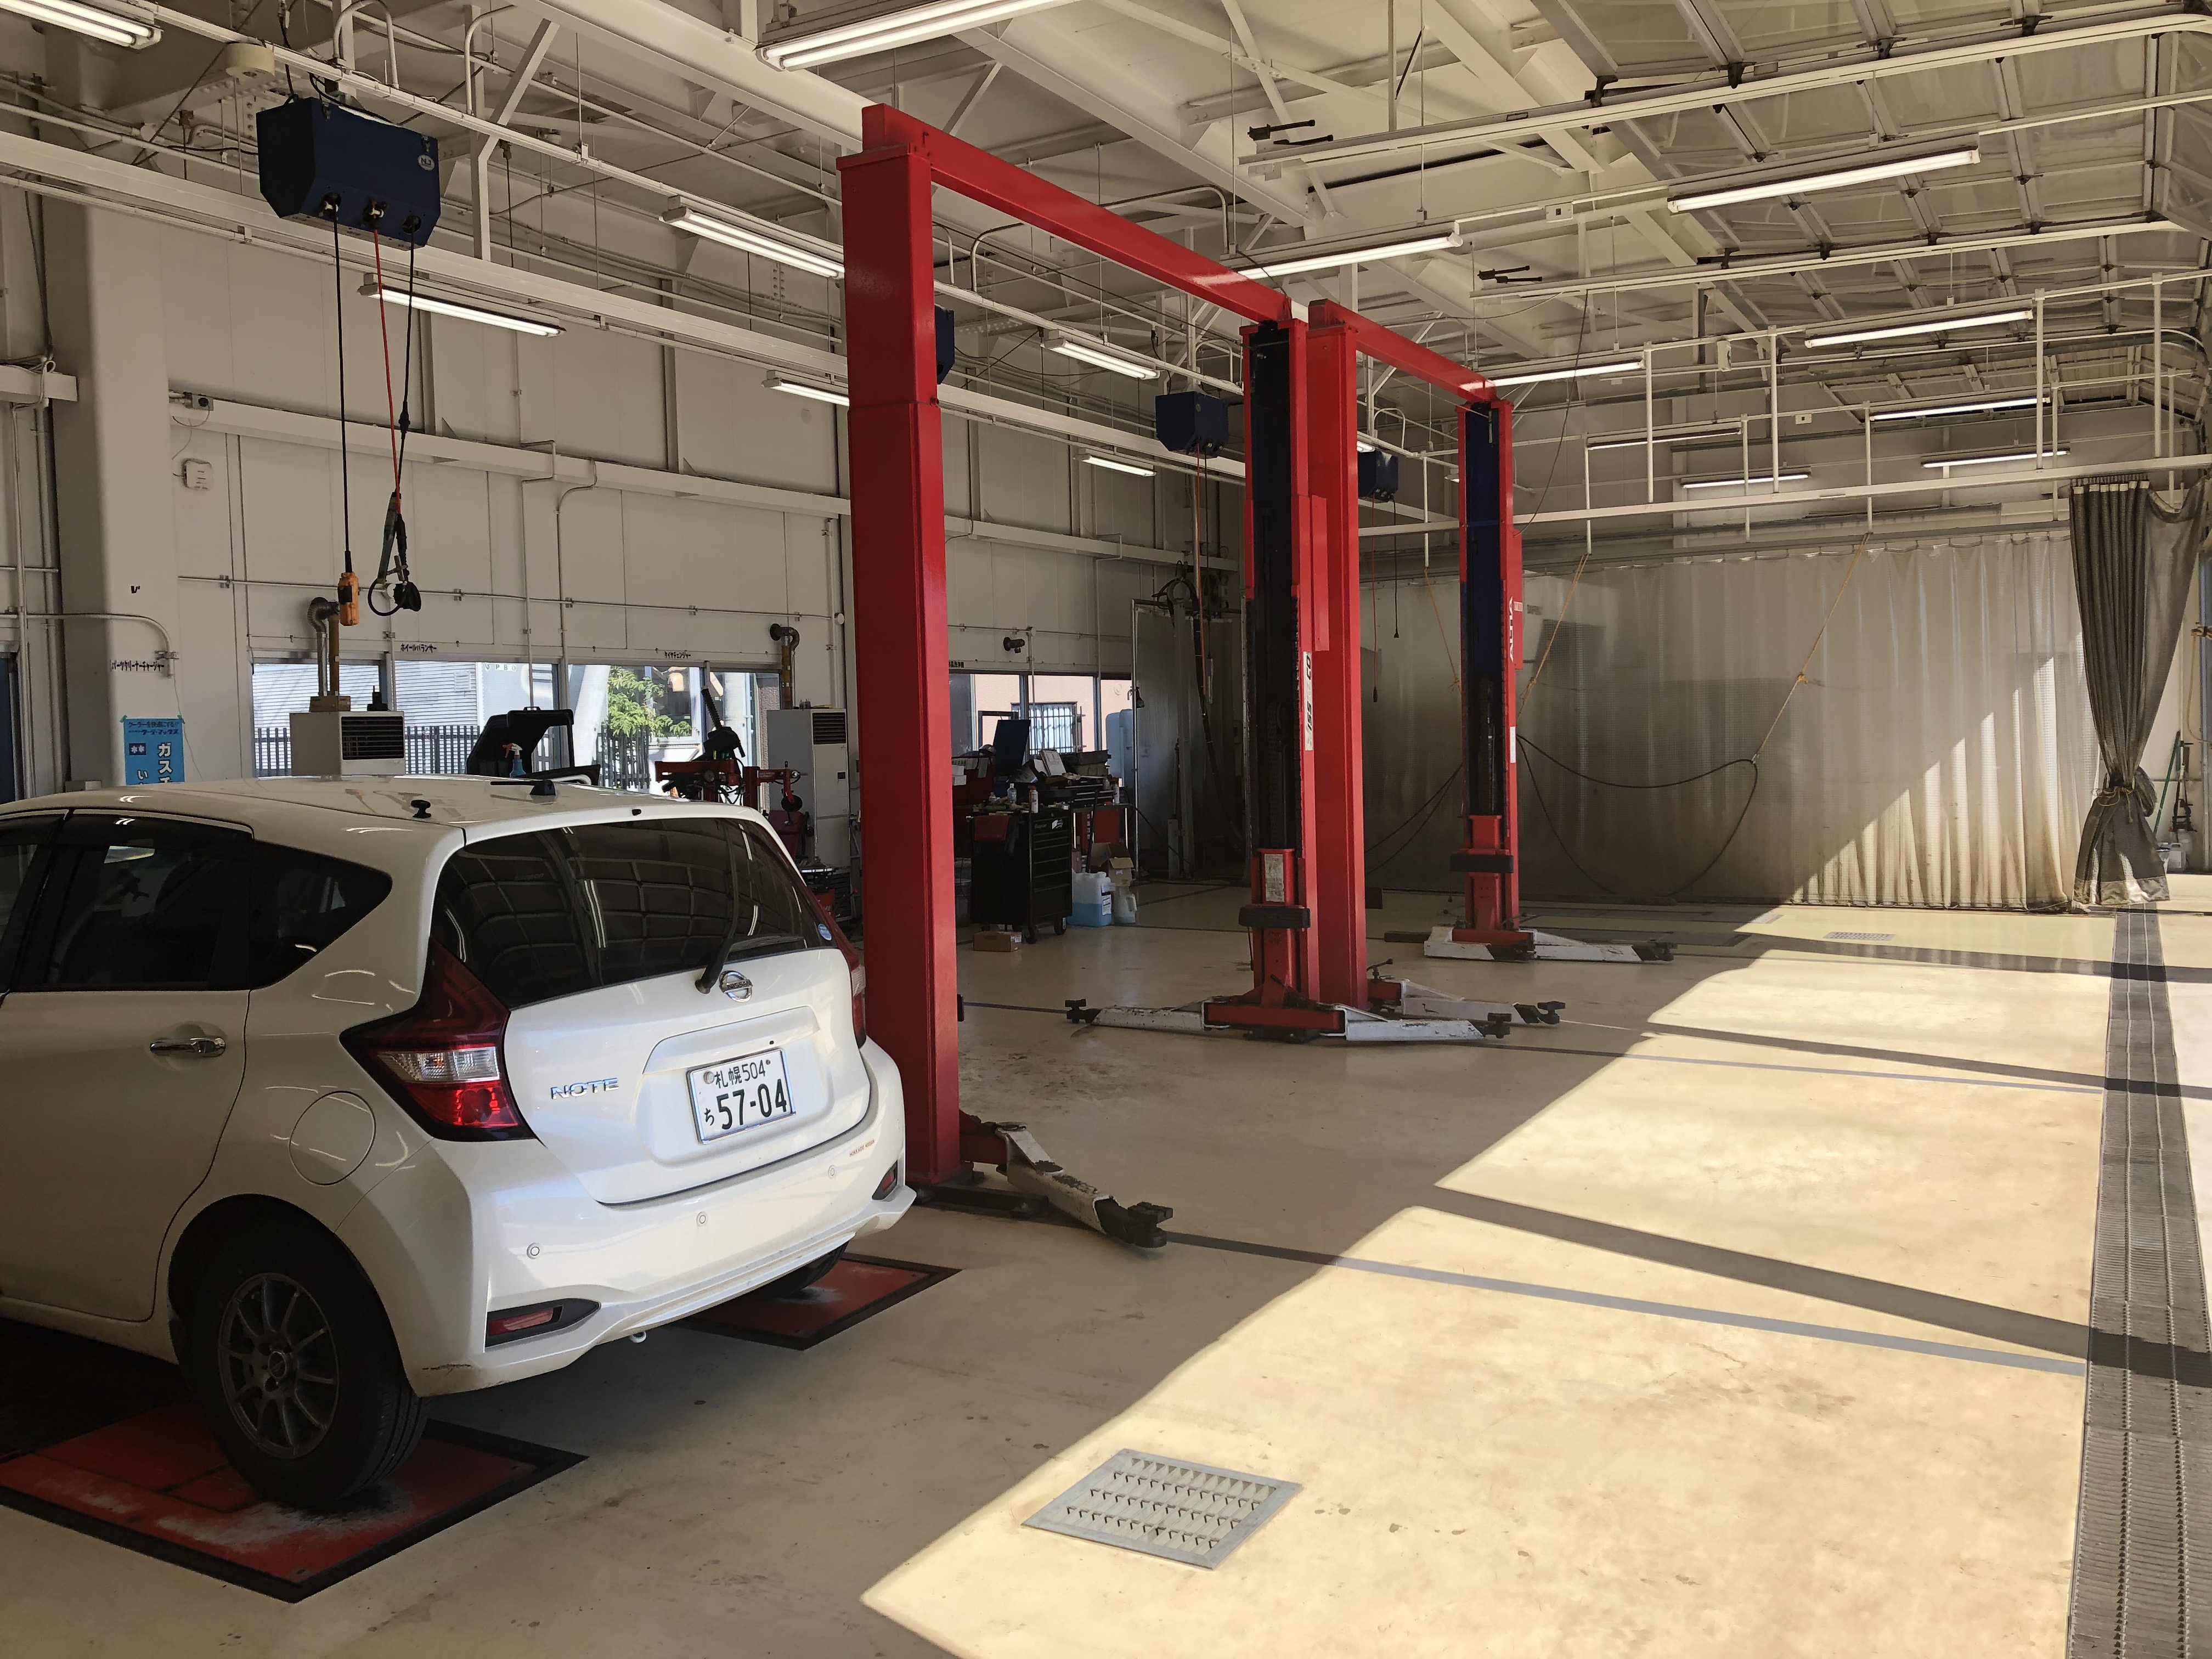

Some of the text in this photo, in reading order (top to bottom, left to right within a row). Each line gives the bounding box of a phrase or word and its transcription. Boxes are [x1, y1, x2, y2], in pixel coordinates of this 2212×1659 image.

[726, 981, 748, 990] NISSAN
[550, 1077, 619, 1100] NOTE
[703, 1079, 787, 1130] ち 57-04
